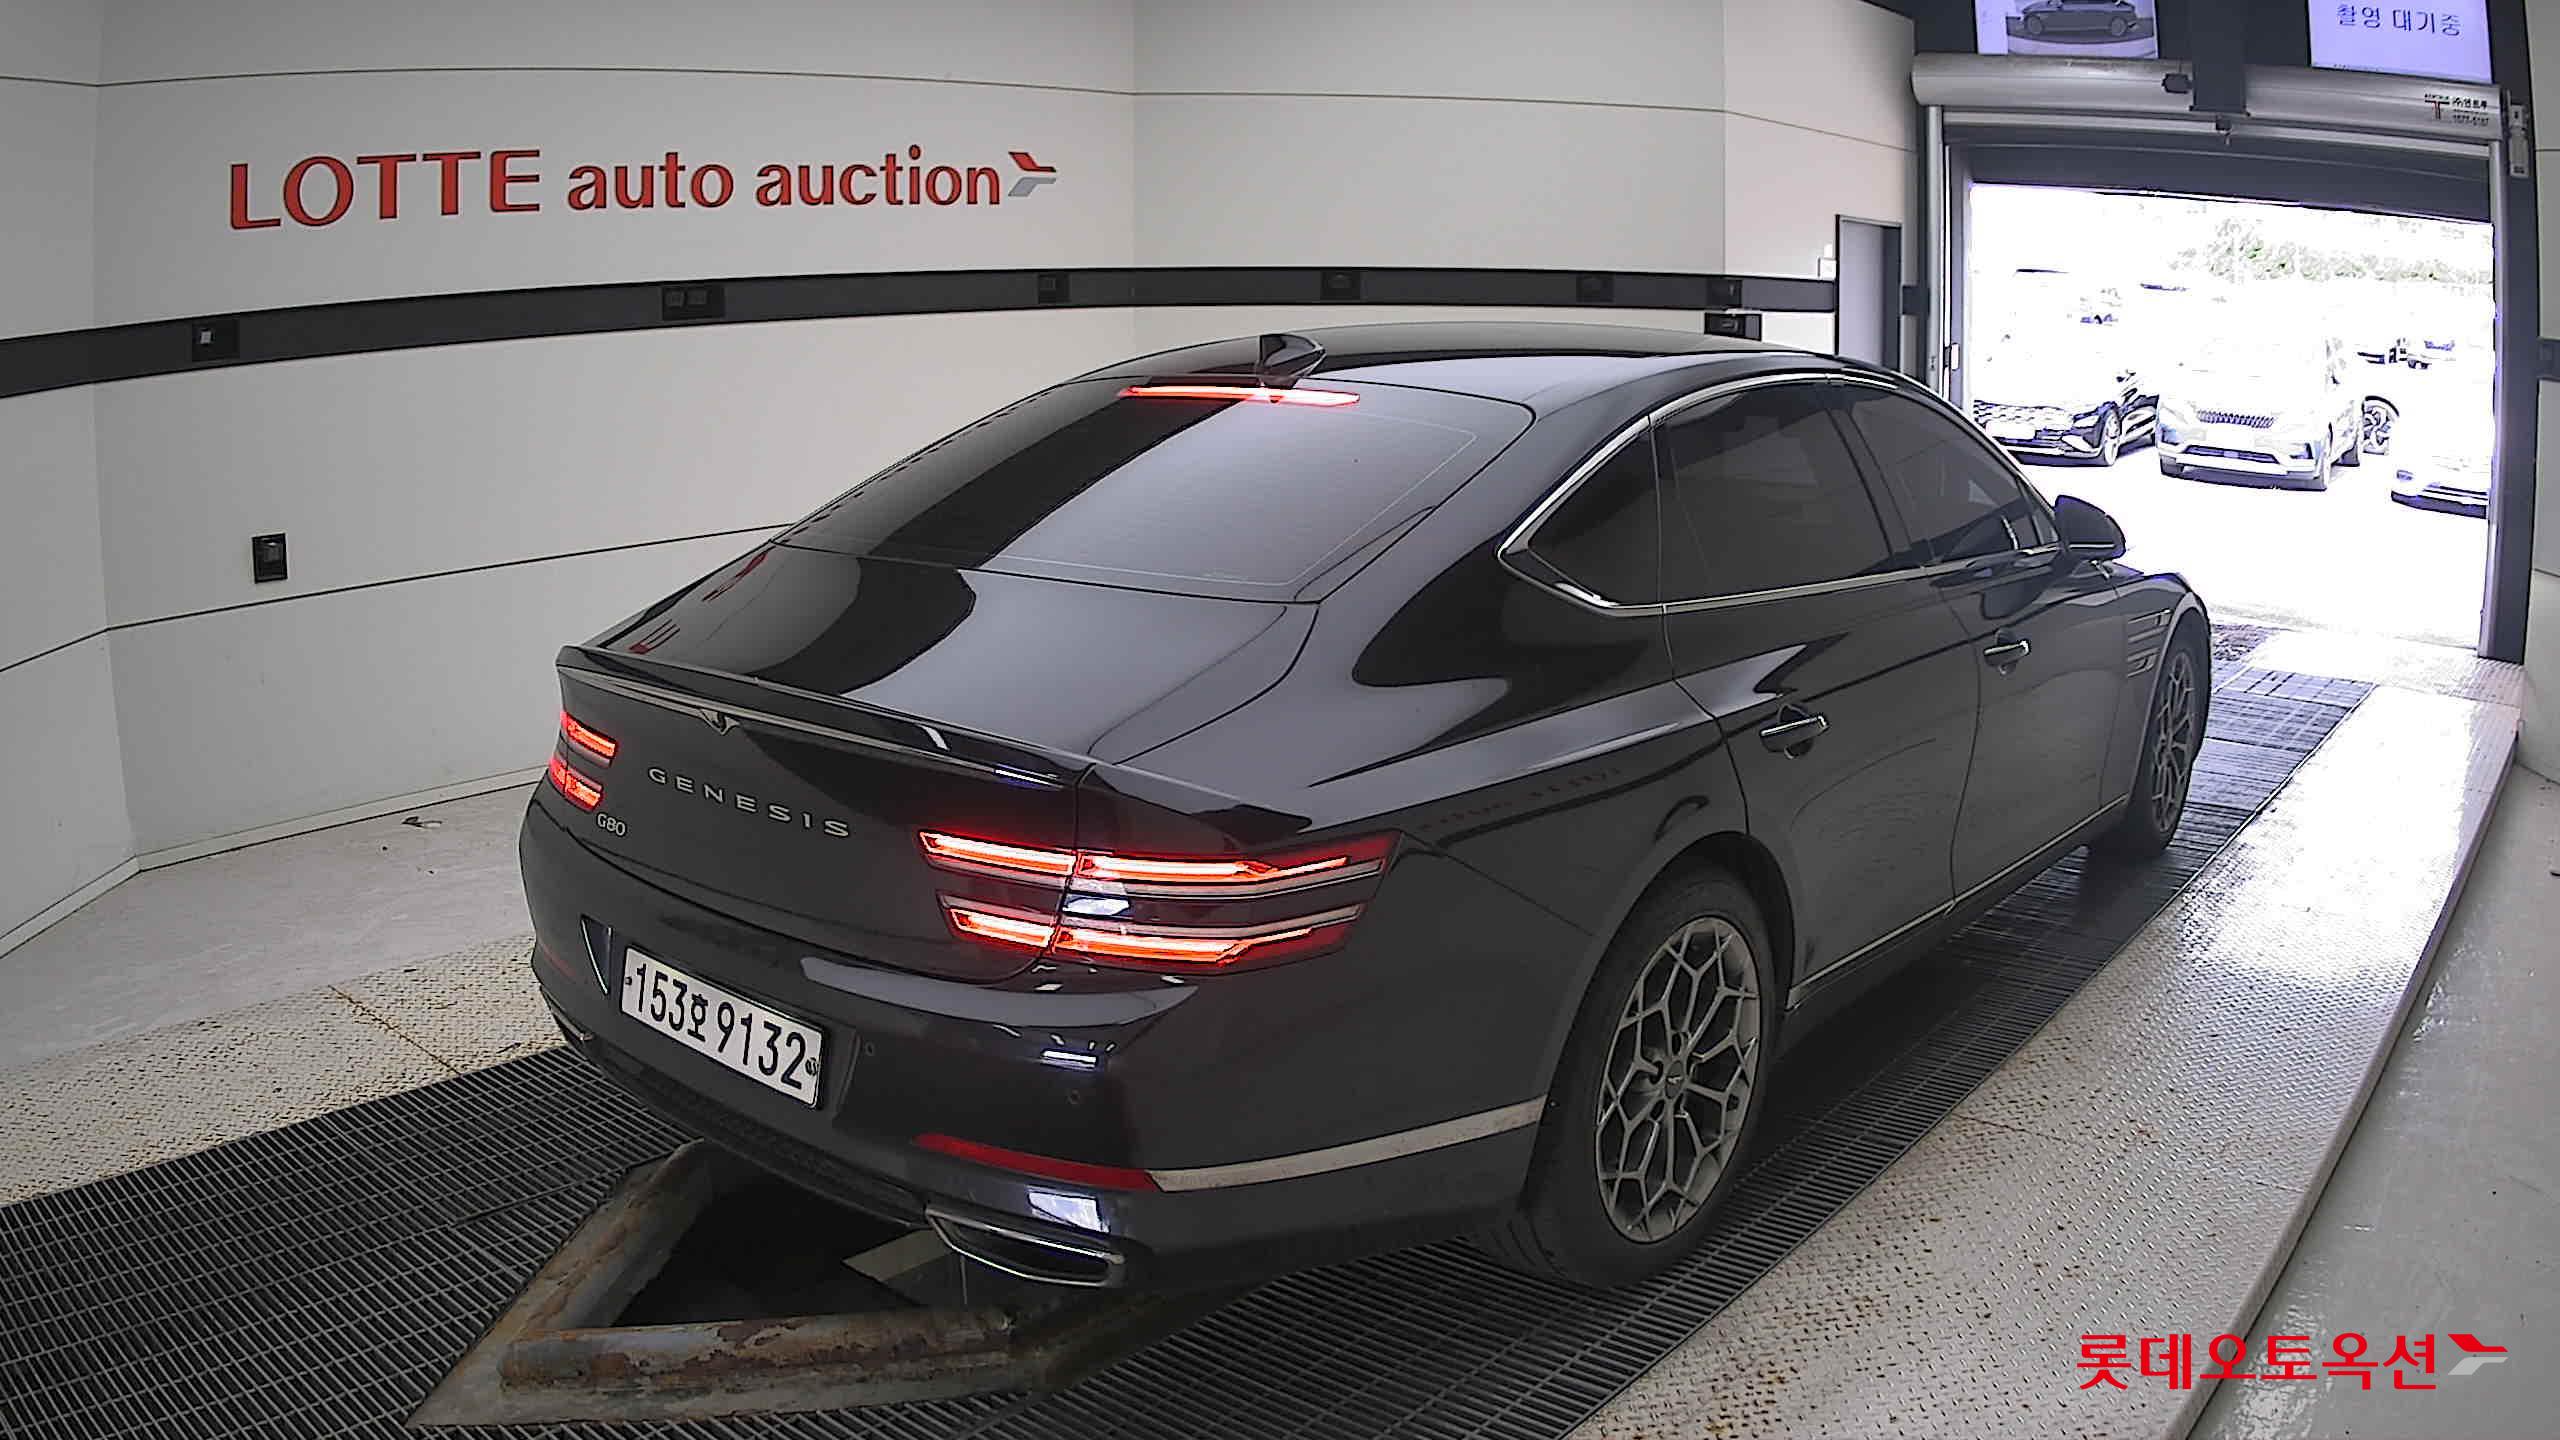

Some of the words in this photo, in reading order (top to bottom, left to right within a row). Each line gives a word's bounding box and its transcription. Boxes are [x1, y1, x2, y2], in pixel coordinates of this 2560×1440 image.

[2337, 4, 2381, 28] 촬영
[2392, 9, 2461, 36] 대기중
[230, 151, 541, 230] LOTTE
[568, 151, 735, 209] auto
[755, 145, 1001, 207] auction
[596, 812, 627, 837] G80
[648, 766, 850, 838] GENESIS
